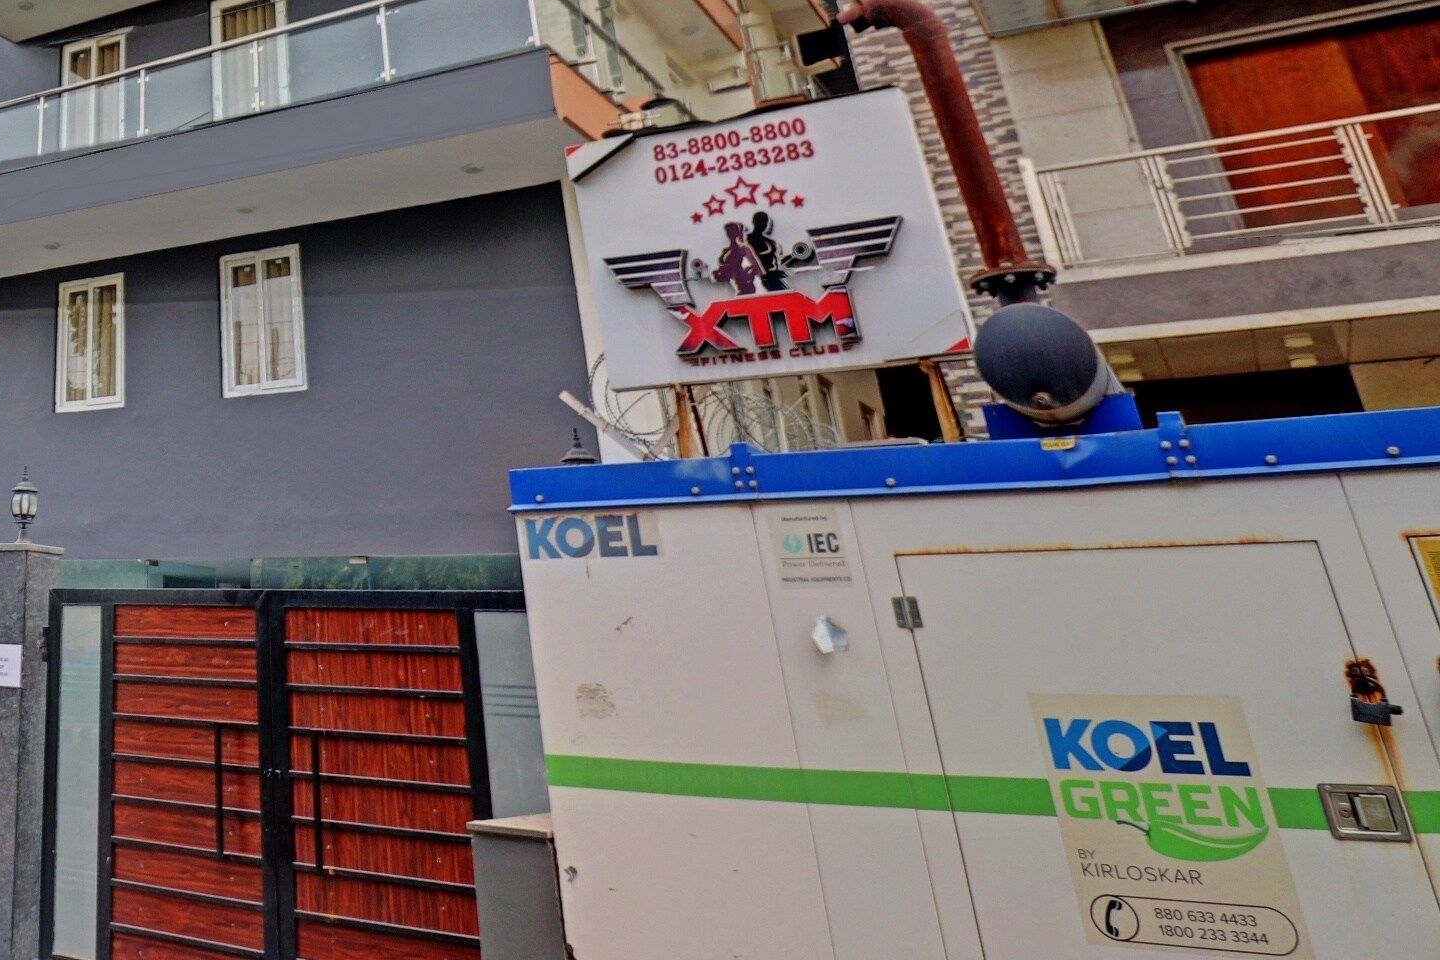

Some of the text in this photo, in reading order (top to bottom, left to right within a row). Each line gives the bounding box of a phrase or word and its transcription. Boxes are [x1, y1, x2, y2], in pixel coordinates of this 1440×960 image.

[653, 117, 806, 162] 83-8800-8800
[654, 140, 815, 184] 0124-2383283
[666, 286, 861, 356] XTM
[701, 343, 841, 367] FITNESS CLUB
[525, 514, 658, 559] KOEL
[806, 532, 840, 553] IEC
[1043, 718, 1252, 777] KOEL
[1060, 779, 1269, 829] GREEN
[1078, 848, 1096, 859] BY
[1081, 862, 1204, 886] KIRLOSKAR
[1154, 907, 1258, 927] 880 633 4433
[1159, 924, 1269, 945] 1800 233 3344
